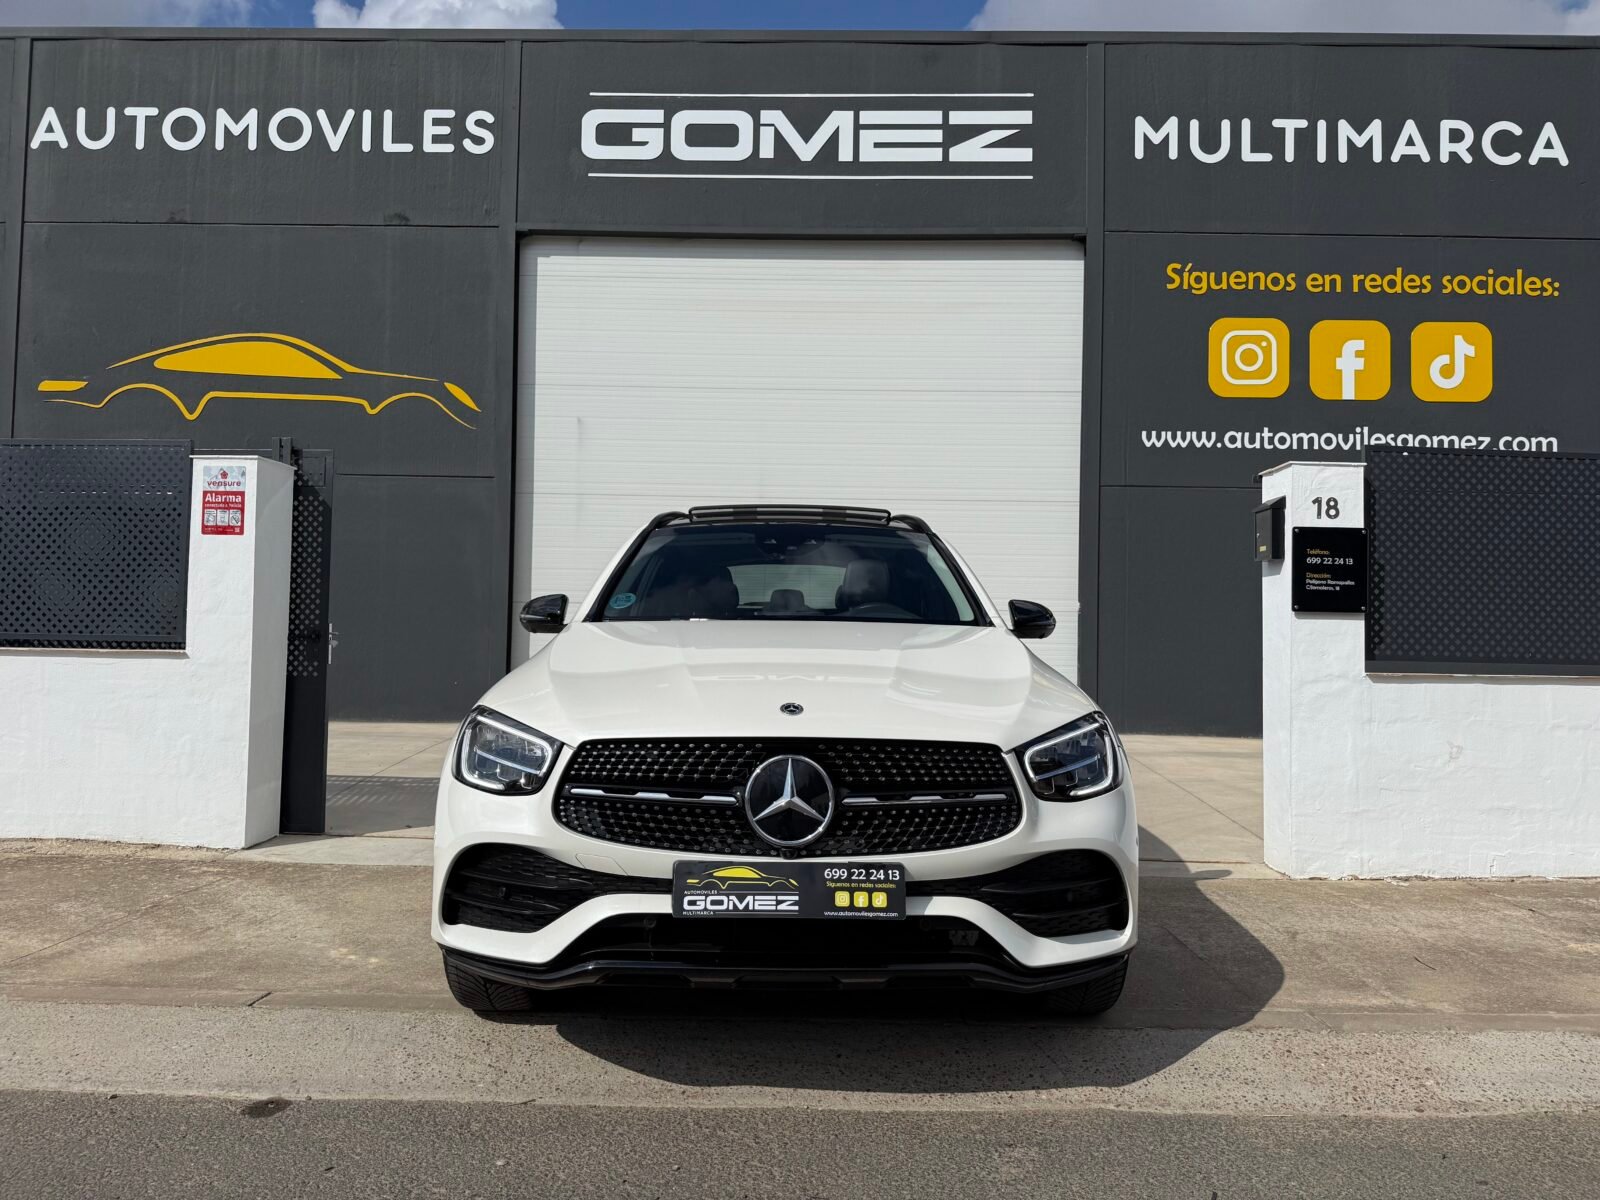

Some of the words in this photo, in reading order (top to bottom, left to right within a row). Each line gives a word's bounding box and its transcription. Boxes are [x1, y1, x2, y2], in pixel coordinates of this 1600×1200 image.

[30, 106, 495, 155] AUTOMOVILES
[580, 108, 1033, 162] GOMEZ
[1134, 115, 1569, 167] MULTIMARCA
[1166, 262, 1297, 296] Síguenos
[1305, 272, 1343, 293] en
[1351, 266, 1433, 295] redes
[1441, 268, 1560, 298] sociales:
[205, 493, 242, 502] Alarma
[1311, 496, 1340, 520] 18
[1306, 556, 1321, 564] 699
[1323, 557, 1333, 565] 22
[1334, 557, 1344, 565] 24
[824, 868, 848, 879] 699
[850, 869, 866, 880] 22
[869, 869, 885, 880] 24
[888, 869, 900, 880] 13
[683, 895, 799, 910] GOMEZ
